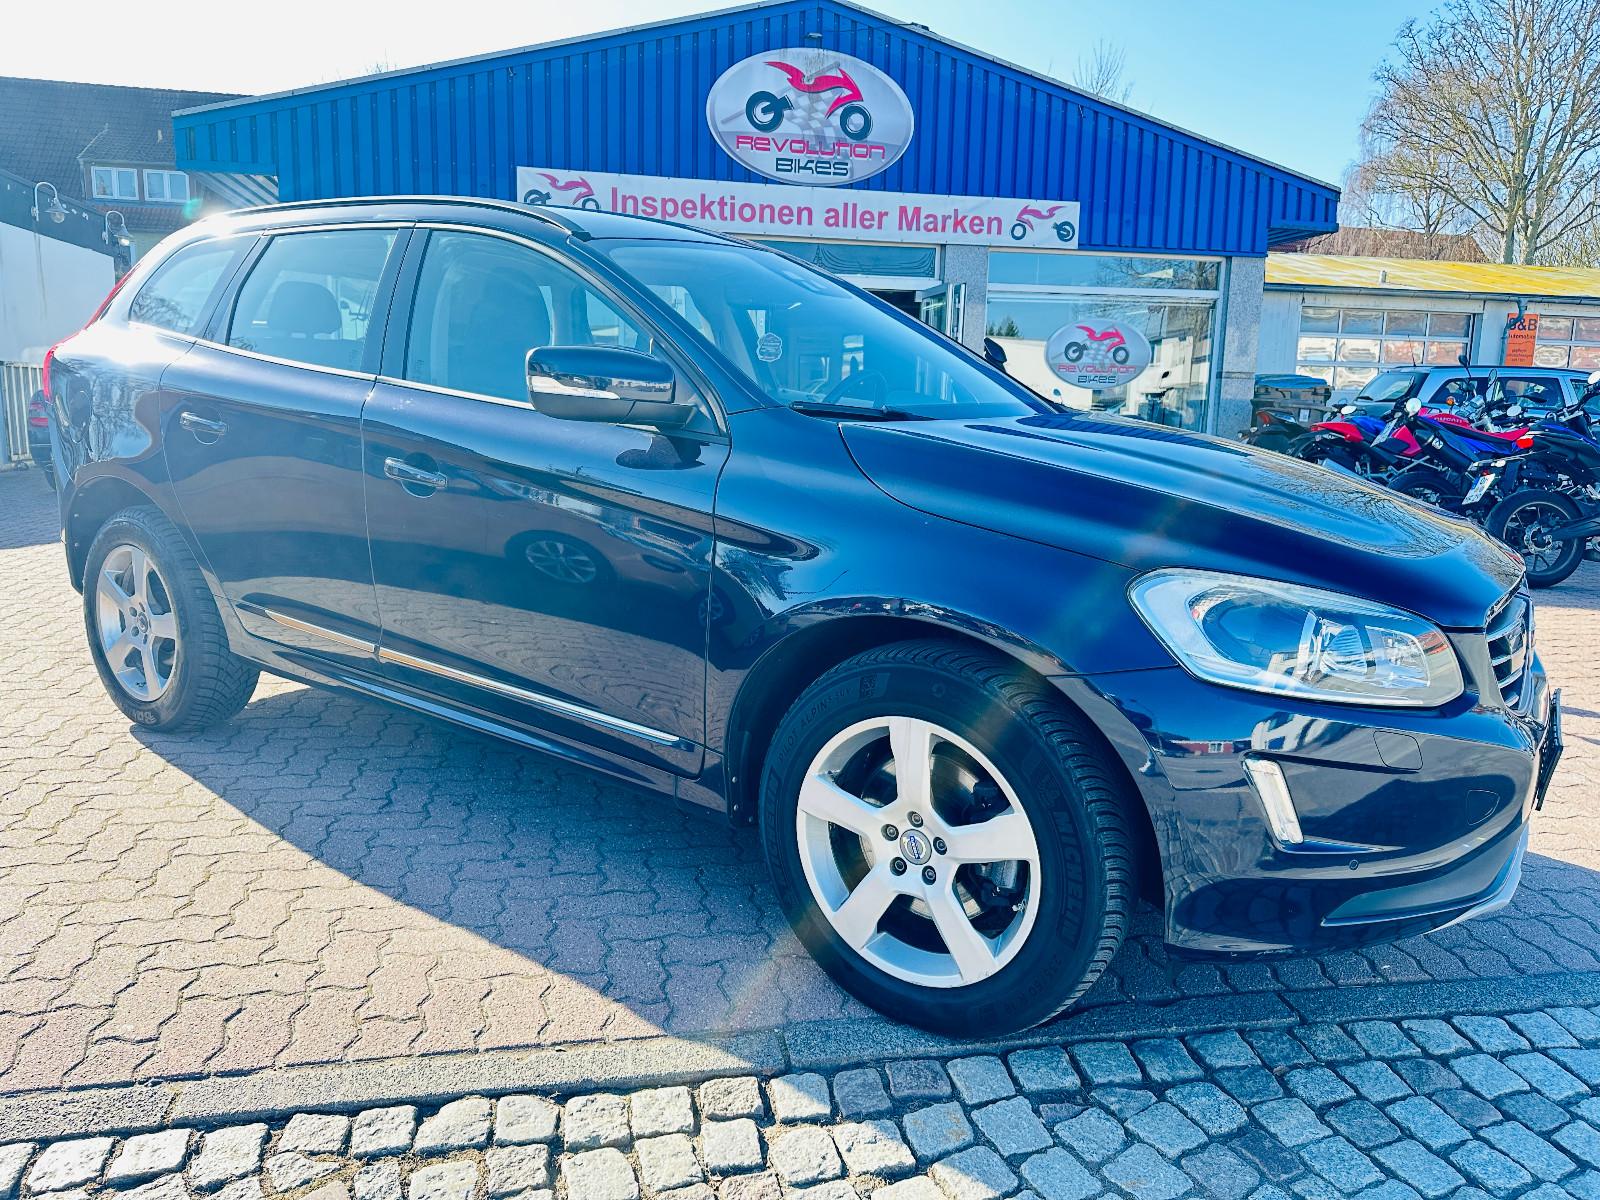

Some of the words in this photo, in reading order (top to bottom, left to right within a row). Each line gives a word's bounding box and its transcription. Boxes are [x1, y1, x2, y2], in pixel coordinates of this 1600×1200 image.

[611, 186, 813, 226] Inspektionen
[824, 202, 889, 230] aller
[898, 205, 1002, 236] Marken
[1052, 810, 1084, 949] MICHELIN
